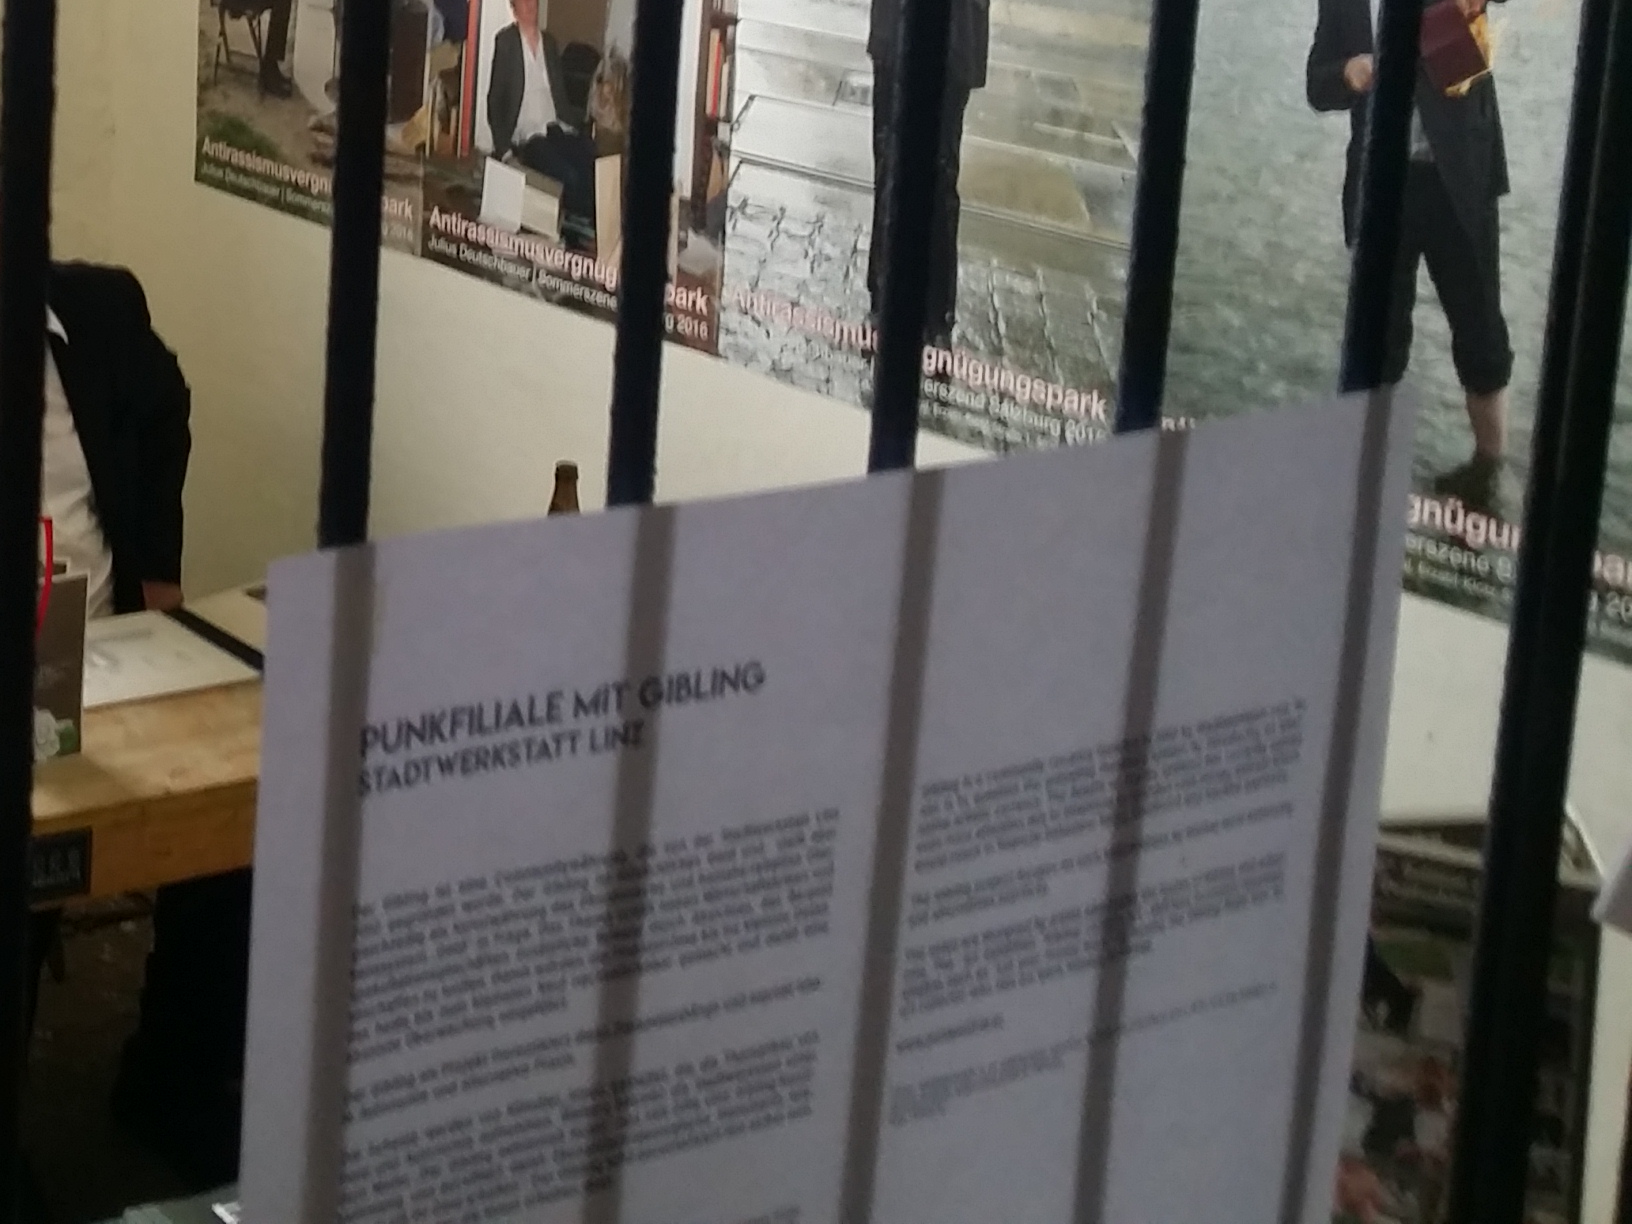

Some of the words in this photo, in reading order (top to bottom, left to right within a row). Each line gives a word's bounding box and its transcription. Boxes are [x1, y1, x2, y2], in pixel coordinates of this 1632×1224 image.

[428, 235, 458, 256] Julius
[458, 244, 531, 279] Deutschbauer
[537, 270, 619, 310] Sommerszene
[676, 314, 708, 340] 2016
[356, 730, 581, 797] STADTWERKSTATT
[587, 717, 646, 756] LINZ
[358, 689, 566, 760] PUNKFILIALE
[572, 679, 630, 718] MIT
[637, 659, 767, 711] GIBLING
